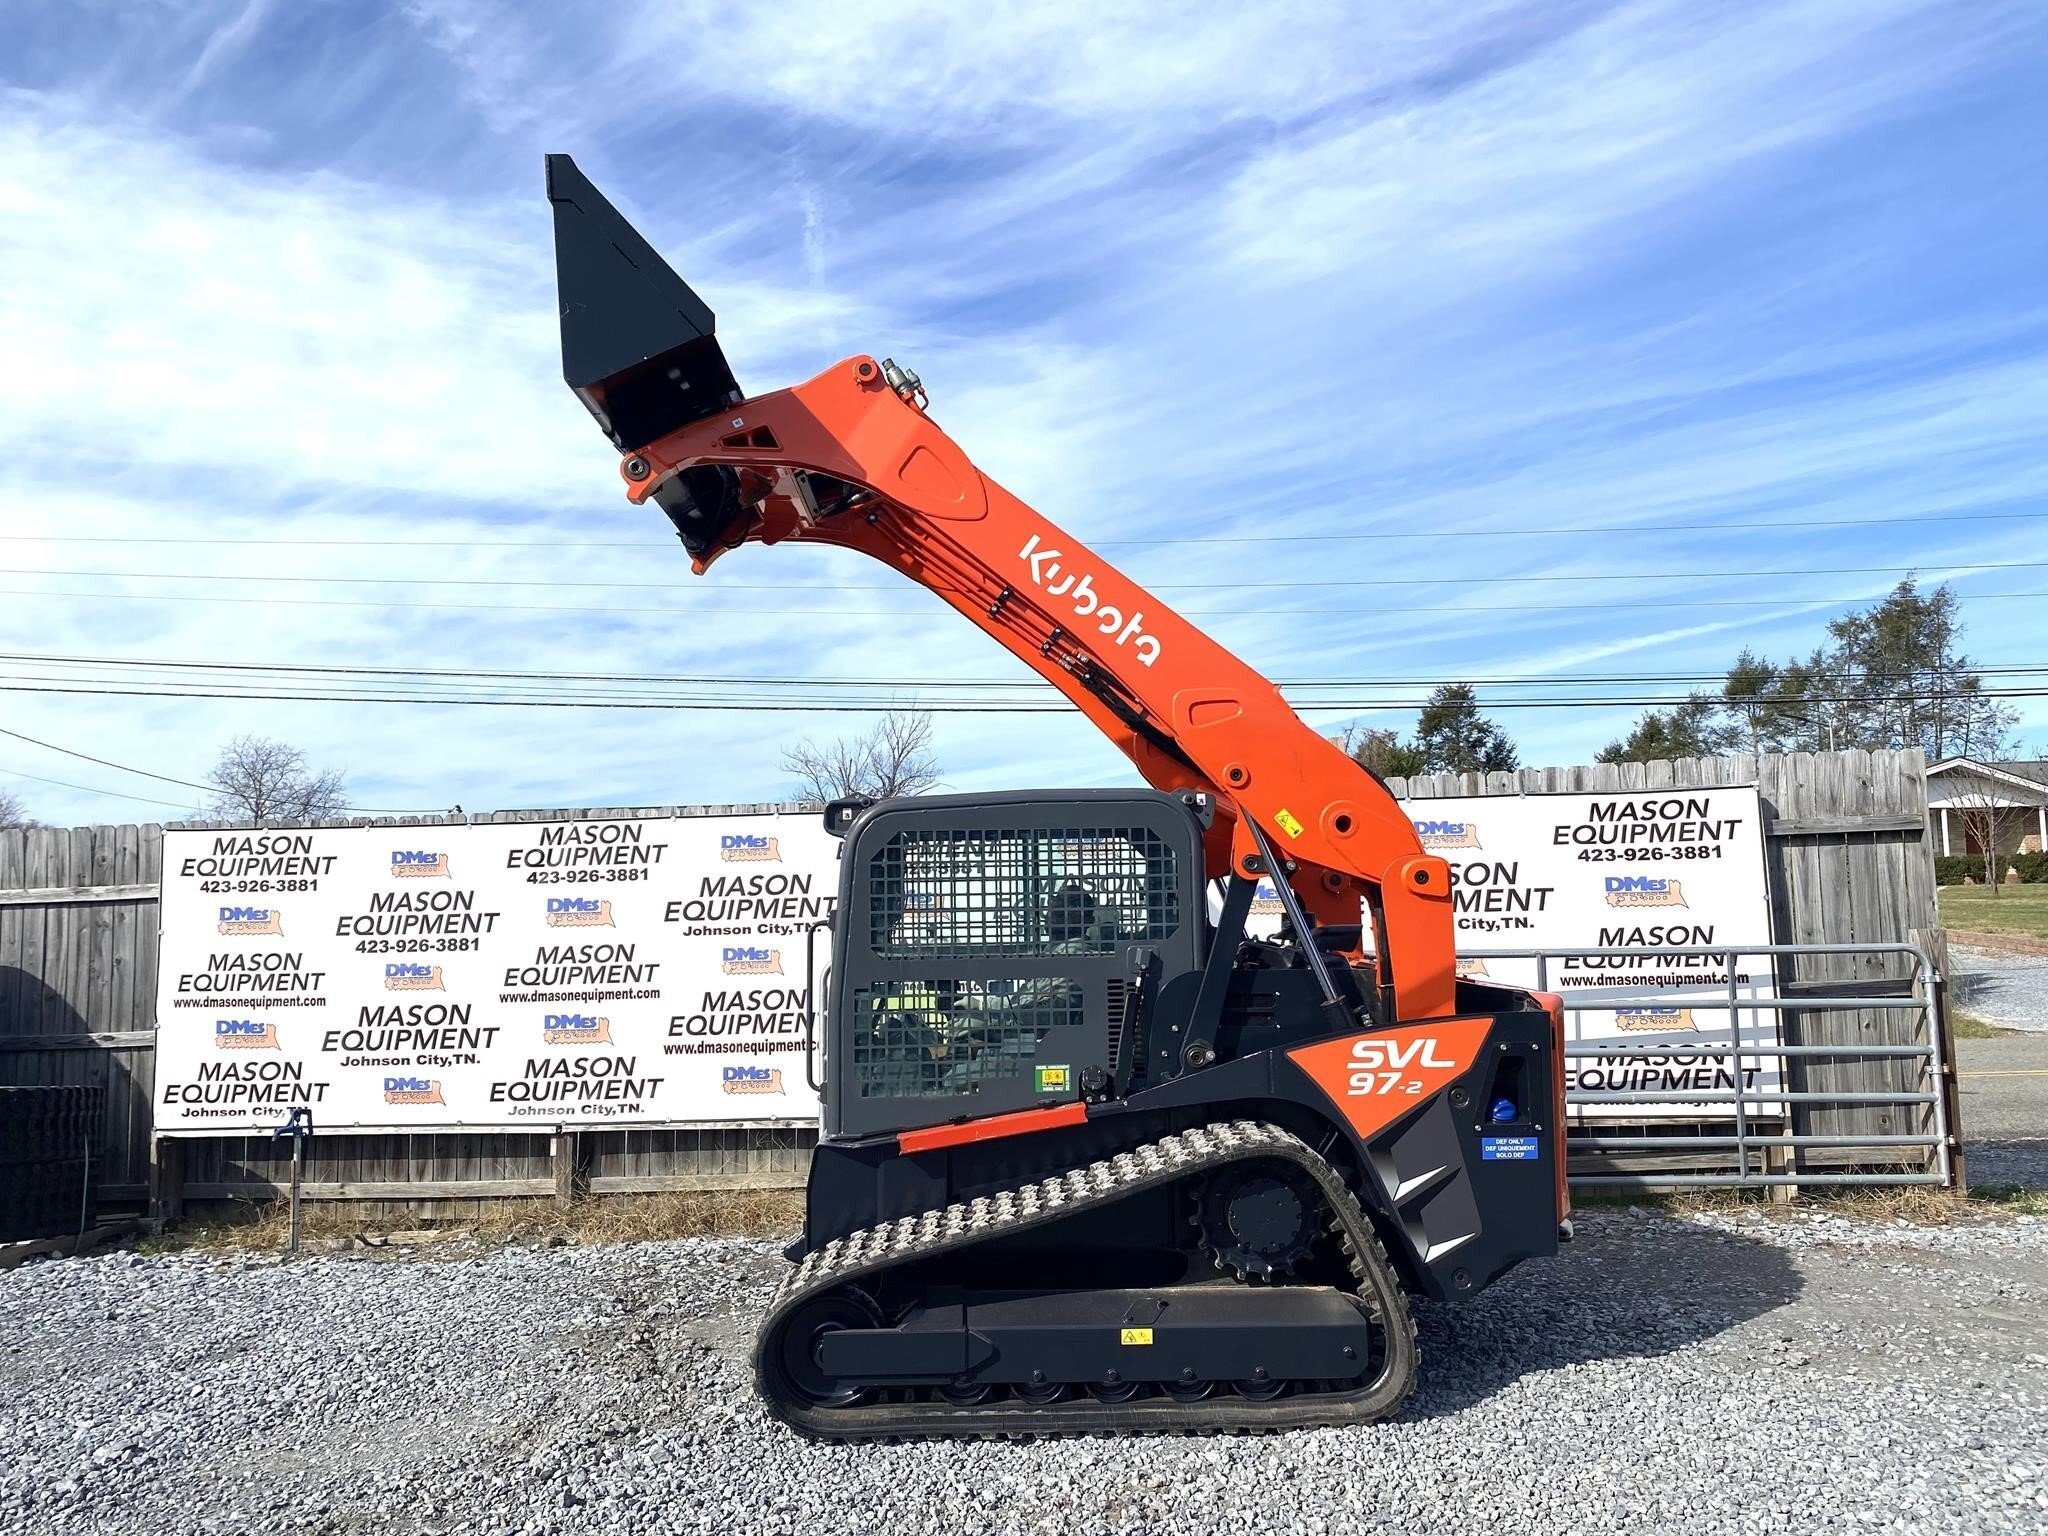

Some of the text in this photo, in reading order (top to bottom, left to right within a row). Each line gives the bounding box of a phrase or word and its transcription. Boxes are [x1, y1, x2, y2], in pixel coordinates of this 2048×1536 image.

[1018, 533, 1161, 668] Kubota
[1589, 798, 1709, 822] MASON
[540, 824, 642, 846] MASON
[1553, 820, 1742, 845] EQUIPMENT
[213, 836, 312, 855] MASON
[507, 844, 668, 868] EQUIPMENT
[1578, 845, 1721, 861] 423-926-3881
[181, 856, 337, 876] EQUIPMENT
[527, 868, 647, 884] 423-926-3881
[1450, 862, 1518, 886] SON
[200, 879, 317, 893] 423-926-3881
[700, 874, 811, 897] MASON
[370, 891, 474, 912] MASON
[664, 896, 838, 922] EQUIPMENT
[336, 913, 500, 936] EQUIPMENT
[683, 926, 751, 936] Johnson
[356, 938, 478, 953] 423-926-3881
[1598, 926, 1714, 946] MASON
[208, 953, 302, 971] MASON
[536, 944, 635, 964] MASON
[178, 973, 325, 992] EQUIPMENT
[504, 964, 659, 986] EQUIPMENT
[174, 996, 325, 1010] www.dmasonequipment.com
[500, 988, 660, 1003] www.dmasonequipment.com
[702, 989, 807, 1012] MASON
[358, 1004, 471, 1027] MASON
[668, 1012, 821, 1036] EQUIPMEN
[322, 1027, 500, 1051] EQUIPMENT
[340, 1056, 410, 1066] Johnson
[1346, 1038, 1456, 1068] SVL
[198, 1062, 302, 1081] MASON
[525, 1057, 636, 1078] MASON
[163, 1083, 329, 1104] EQUIPMENT
[490, 1079, 664, 1102] EQUIPMENT
[1347, 1072, 1423, 1095] 97-2
[182, 1108, 246, 1117] Johnson
[509, 1106, 574, 1115] Johnson
